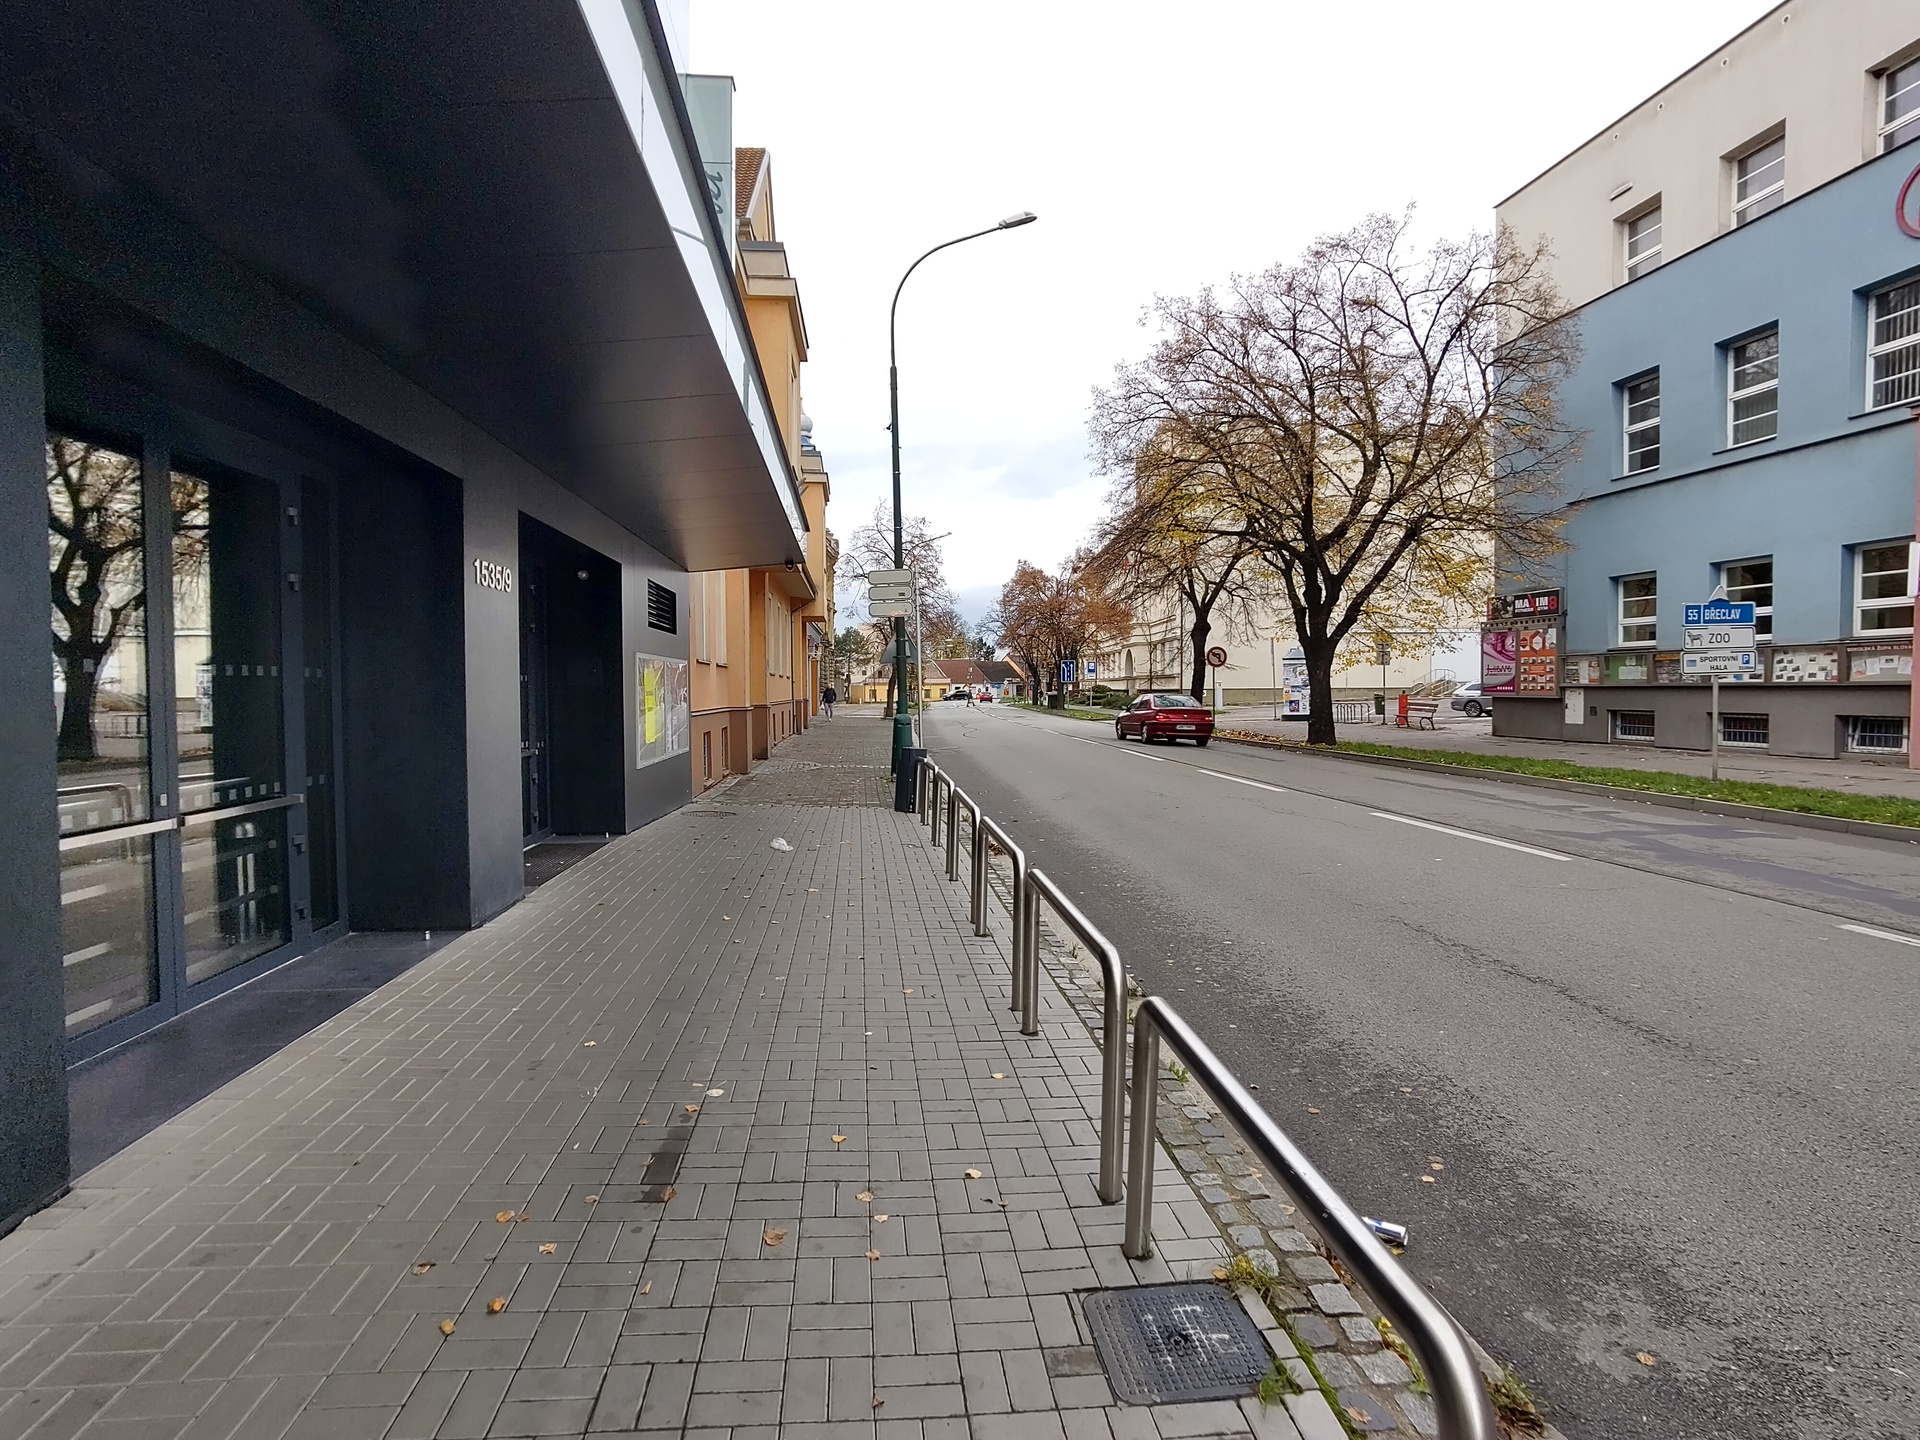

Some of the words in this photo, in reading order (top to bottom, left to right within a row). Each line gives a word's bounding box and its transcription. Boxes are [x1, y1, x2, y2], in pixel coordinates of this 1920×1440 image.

[474, 558, 512, 593] 1535/9
[1688, 609, 1699, 620] 55
[1704, 607, 1741, 620] BŘECLAV
[1708, 633, 1731, 644] ZOO
[1699, 655, 1738, 663] SPORTOVNÍ
